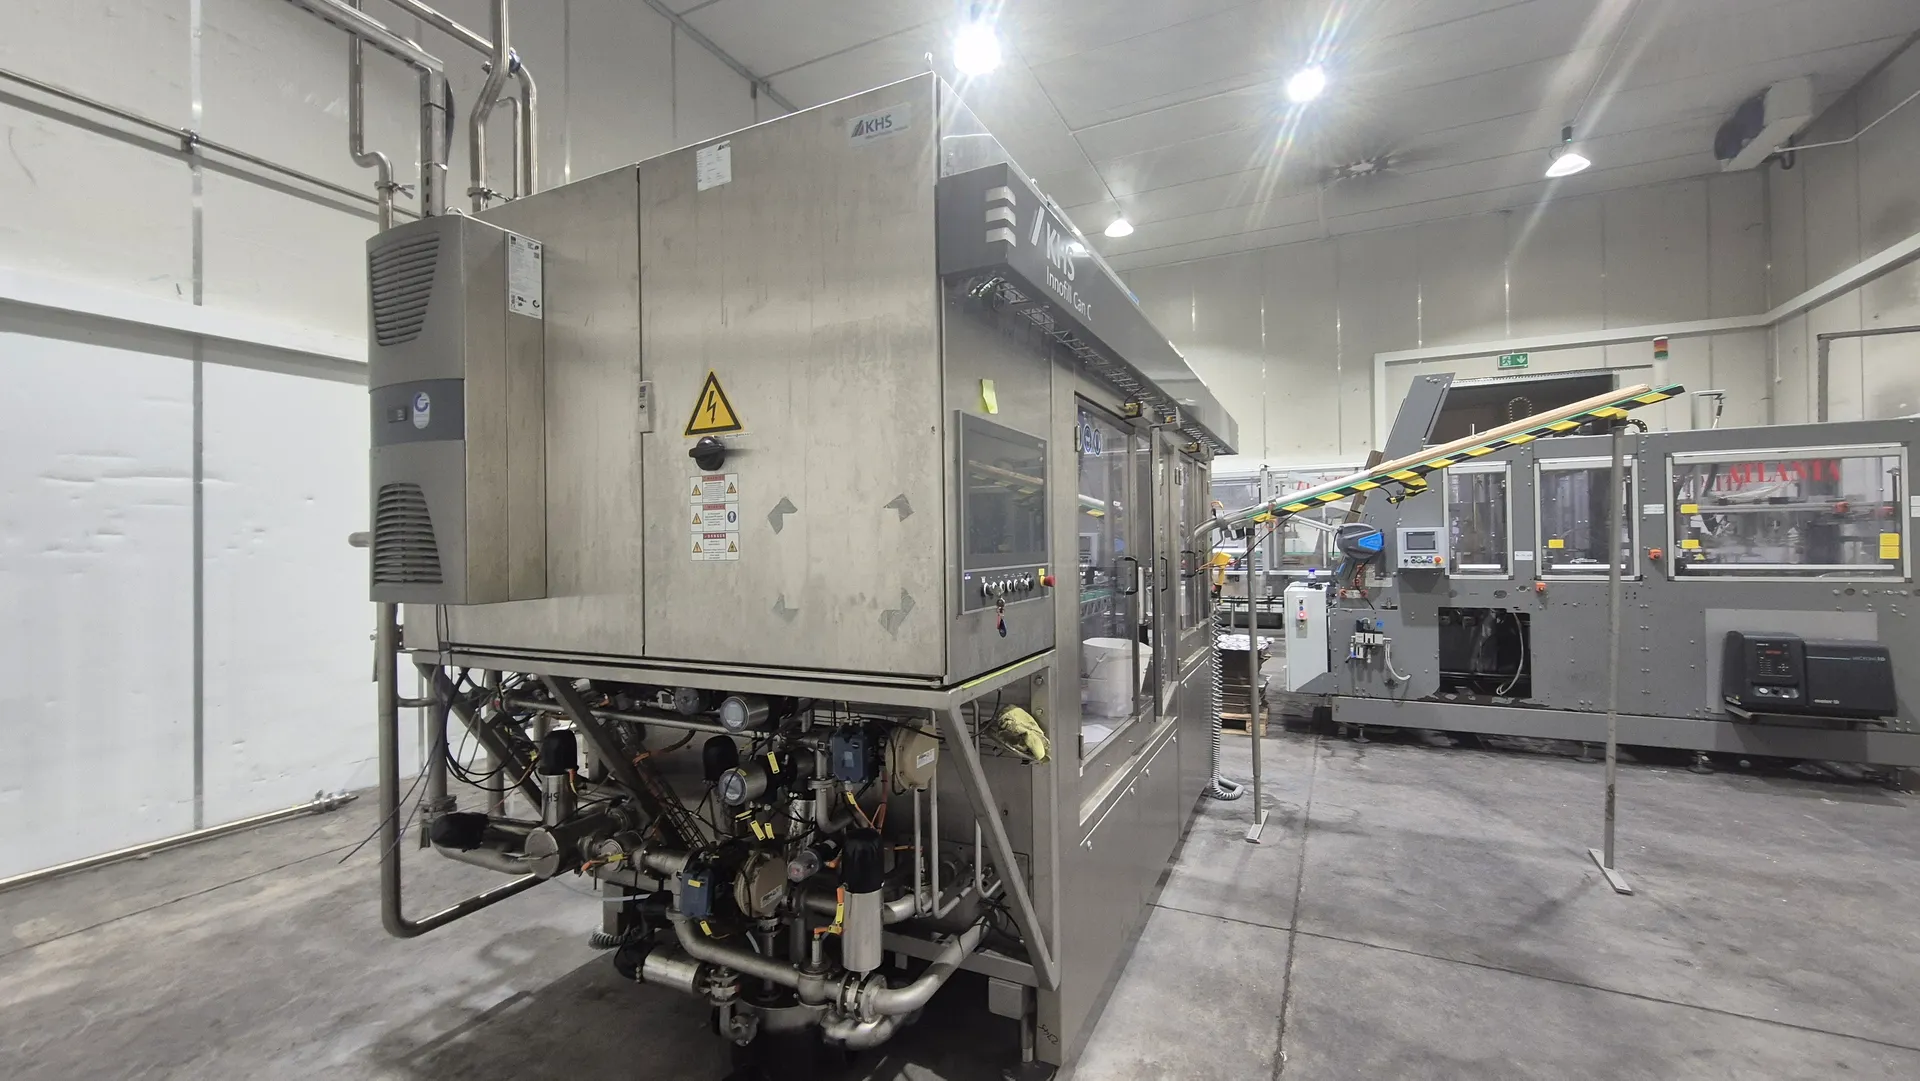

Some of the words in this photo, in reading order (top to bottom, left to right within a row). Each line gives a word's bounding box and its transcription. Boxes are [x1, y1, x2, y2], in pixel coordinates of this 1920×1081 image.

[866, 114, 893, 134] KHS
[1046, 222, 1075, 281] KHS
[1046, 265, 1072, 304] Innofill
[1073, 291, 1087, 317] Can
[1087, 305, 1092, 321] C
[1728, 458, 1840, 484] ATLANTA
